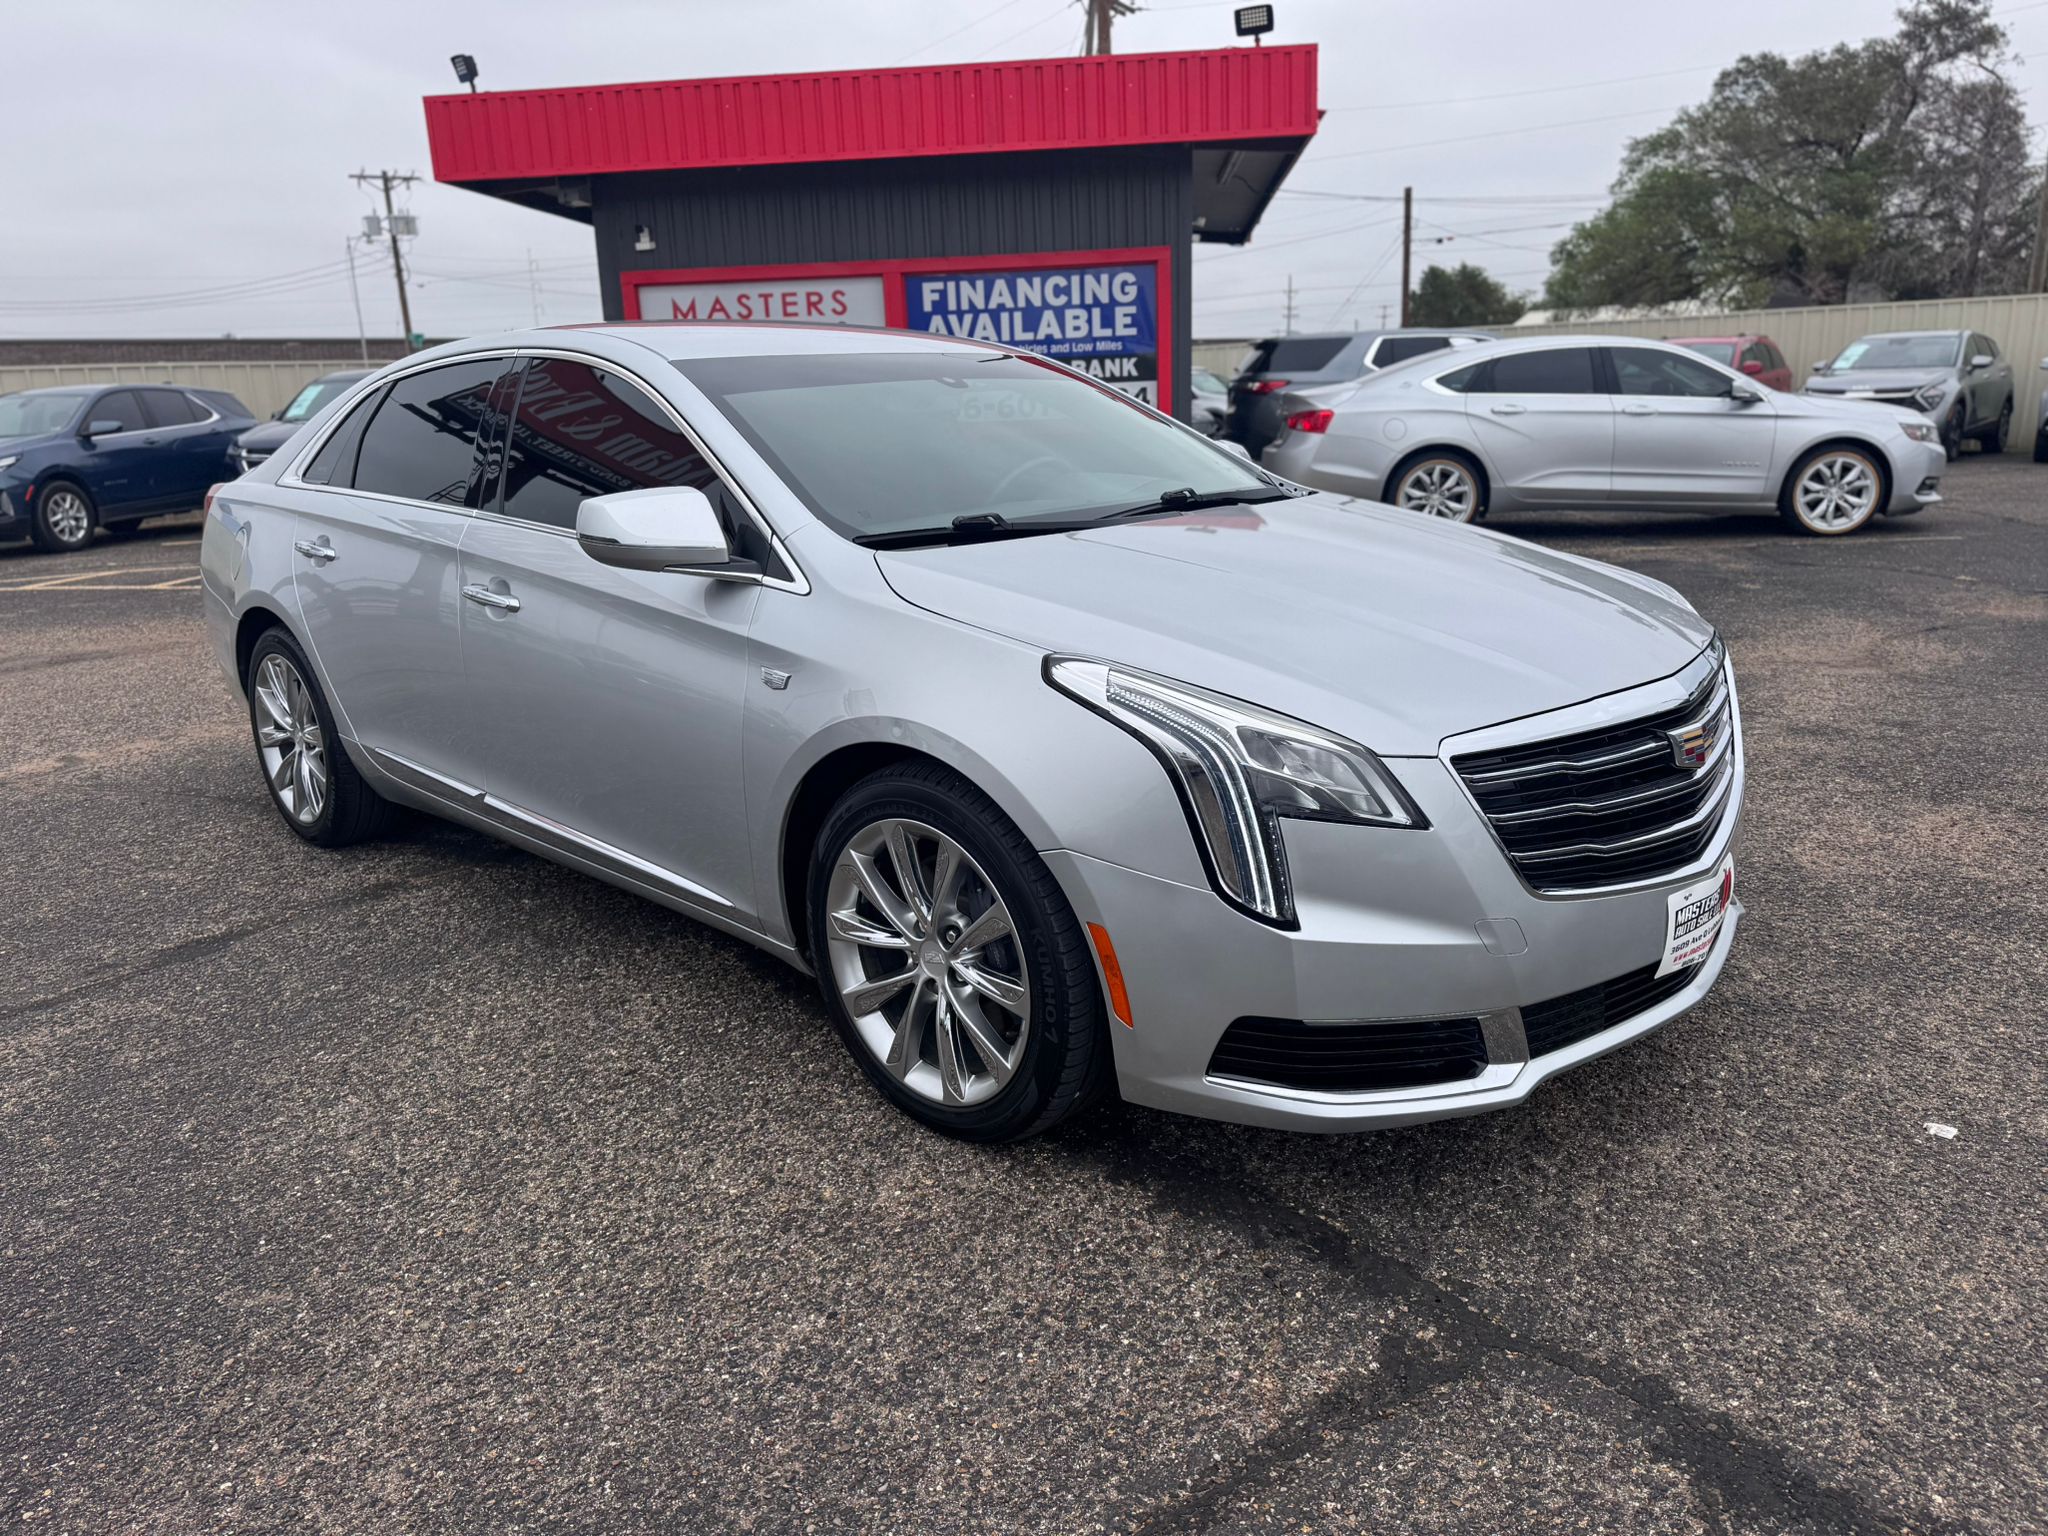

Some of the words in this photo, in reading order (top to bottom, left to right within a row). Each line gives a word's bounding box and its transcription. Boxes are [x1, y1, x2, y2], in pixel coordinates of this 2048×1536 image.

[671, 289, 848, 321] MASTERS
[921, 271, 1138, 312] FINANCING
[928, 305, 1138, 341] AVAILABLE
[1050, 343, 1071, 353] and
[1072, 341, 1094, 352] Low
[1096, 340, 1123, 351] Miles
[1071, 357, 1138, 379] BANK
[1676, 889, 1720, 925] MASTERS
[1674, 917, 1698, 938] AUTO
[1030, 927, 1057, 1023] KUMHO
